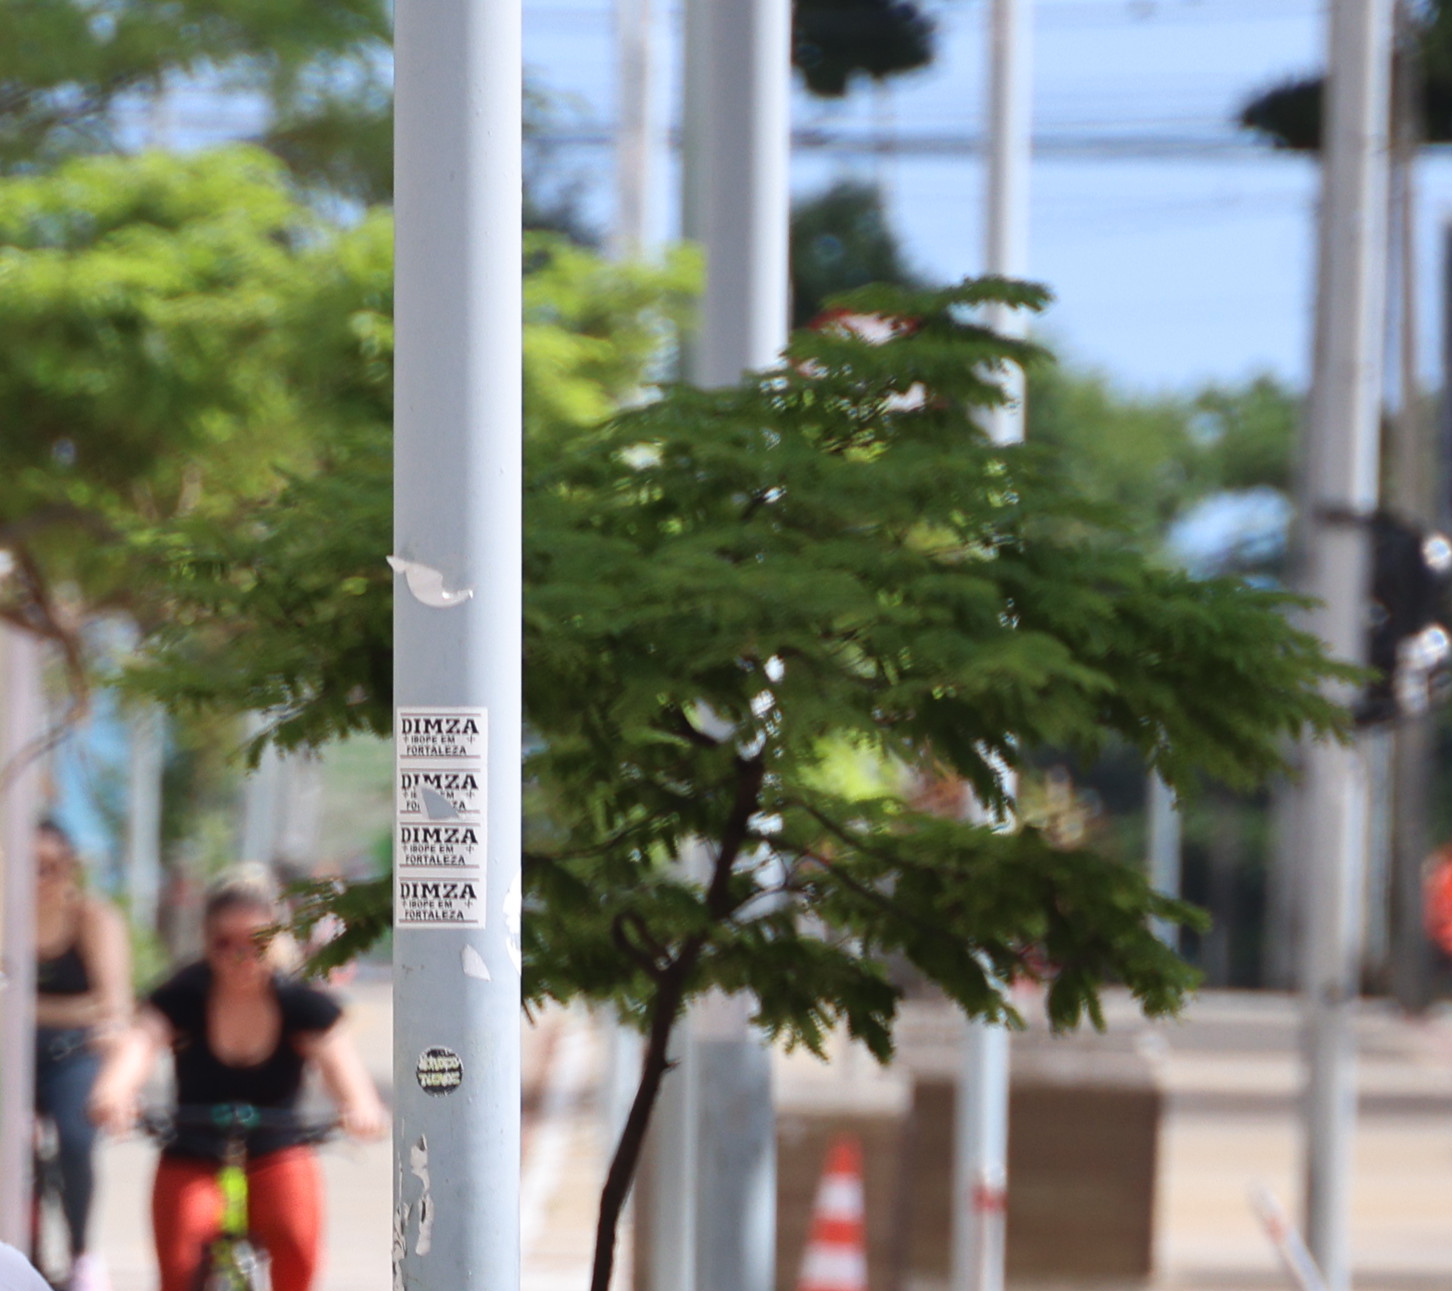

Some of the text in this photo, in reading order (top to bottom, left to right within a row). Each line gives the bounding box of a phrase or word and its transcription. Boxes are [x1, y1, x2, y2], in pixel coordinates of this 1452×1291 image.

[401, 719, 479, 734] DIMZA
[407, 745, 467, 755] FORTALEZA
[401, 774, 478, 789] DIMZA
[401, 828, 478, 844] DIMZA
[405, 855, 465, 865] FORTALEZA
[400, 883, 477, 899] DIMZA
[405, 910, 464, 920] FORTALEZA
